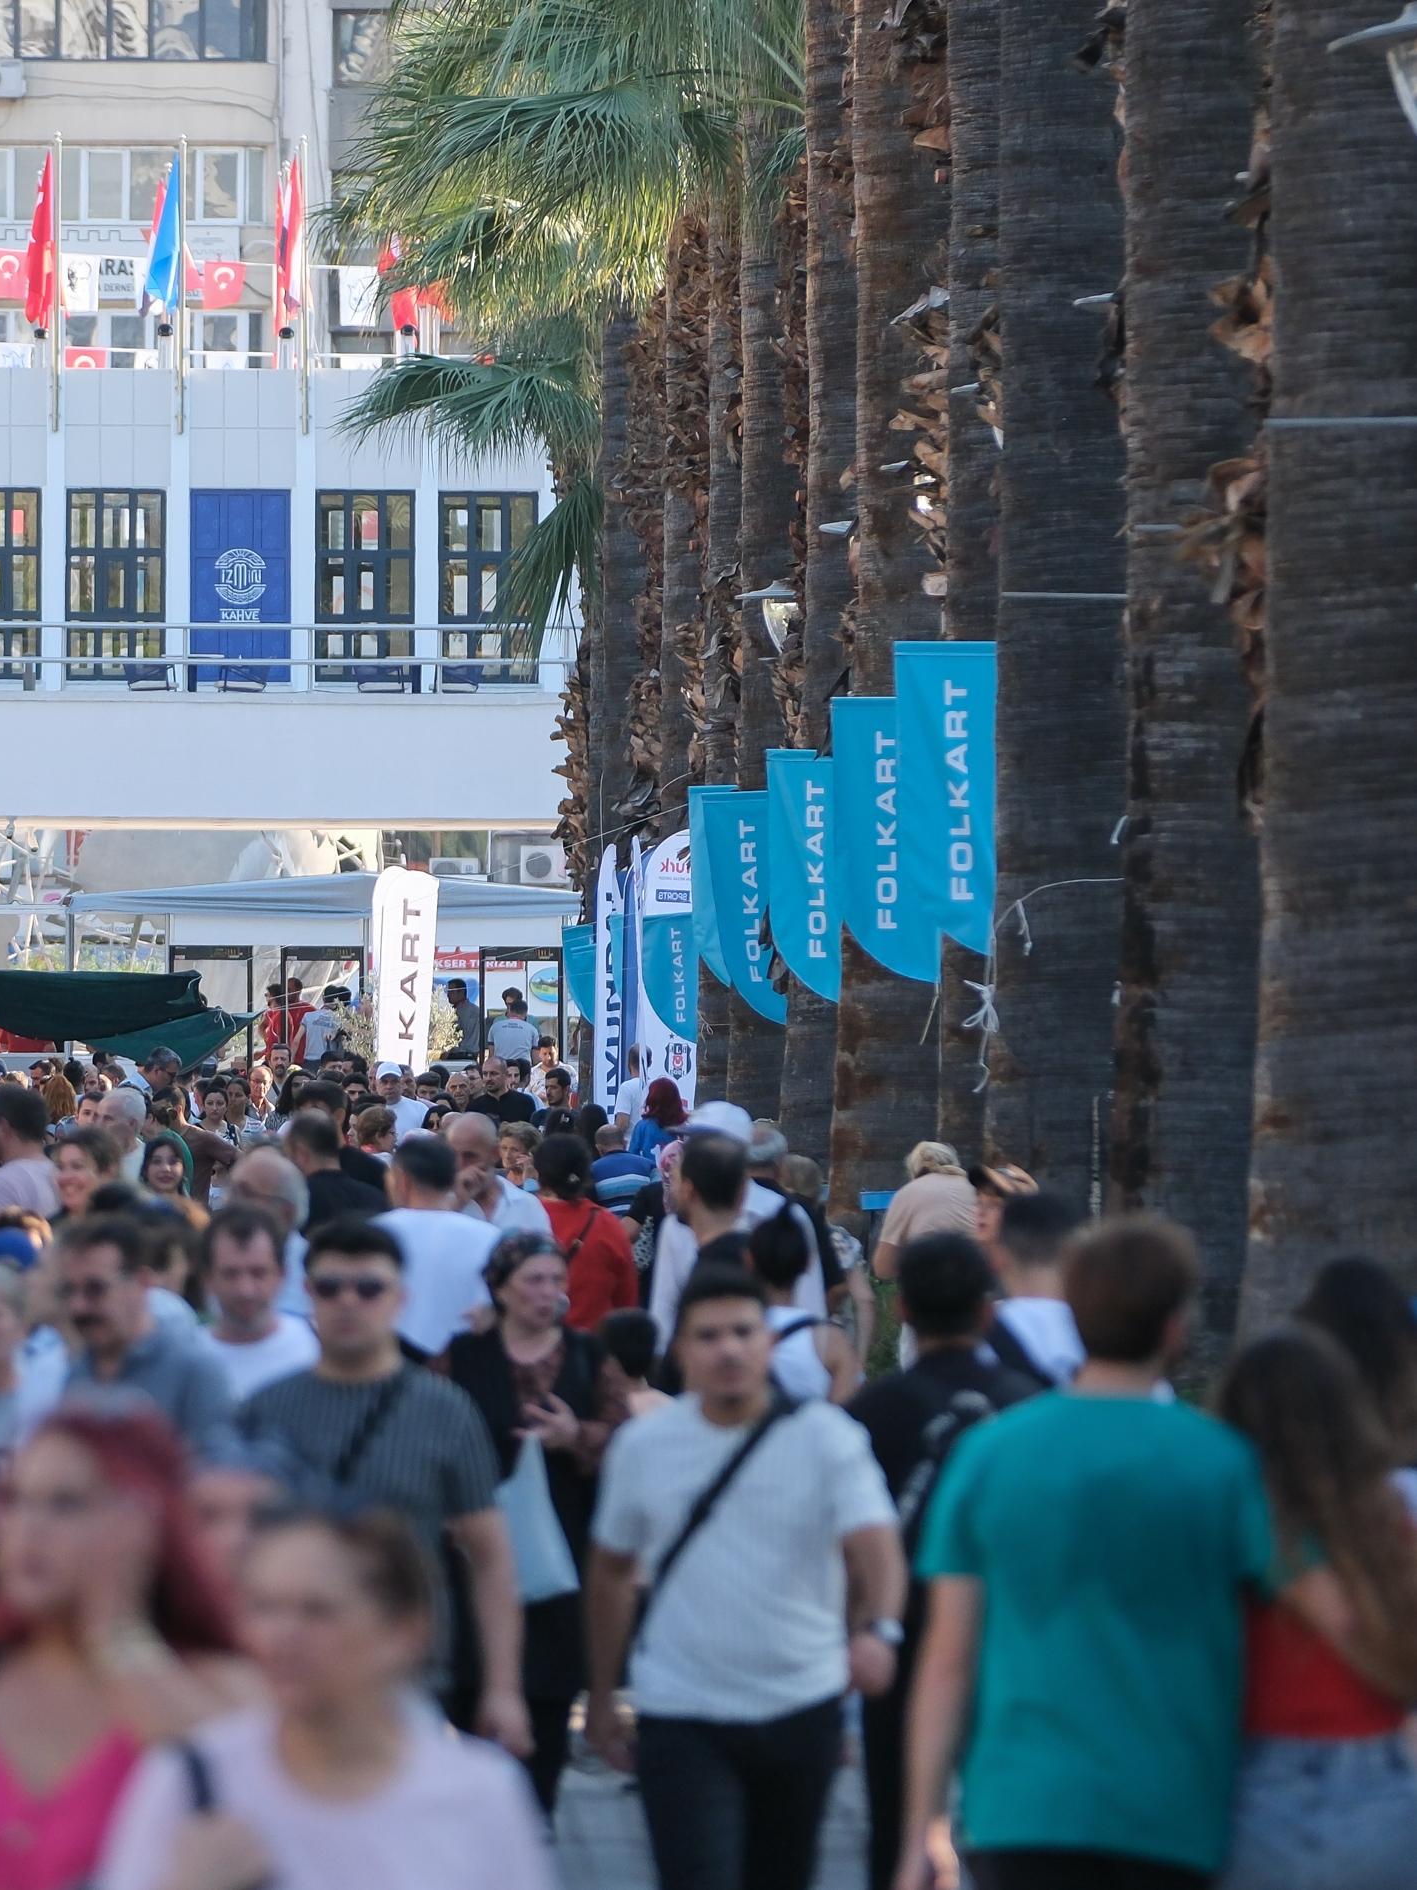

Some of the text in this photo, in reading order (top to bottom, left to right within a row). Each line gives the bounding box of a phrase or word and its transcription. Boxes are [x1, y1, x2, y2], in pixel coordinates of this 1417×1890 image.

[221, 609, 260, 622] KAHVE
[805, 779, 828, 959] FOLKART
[875, 730, 898, 930] FOLKART
[943, 679, 975, 902] FOLKART
[469, 959, 518, 968] TRIZM
[670, 927, 687, 1024] FOLKART
[738, 819, 763, 983] FOLKART
